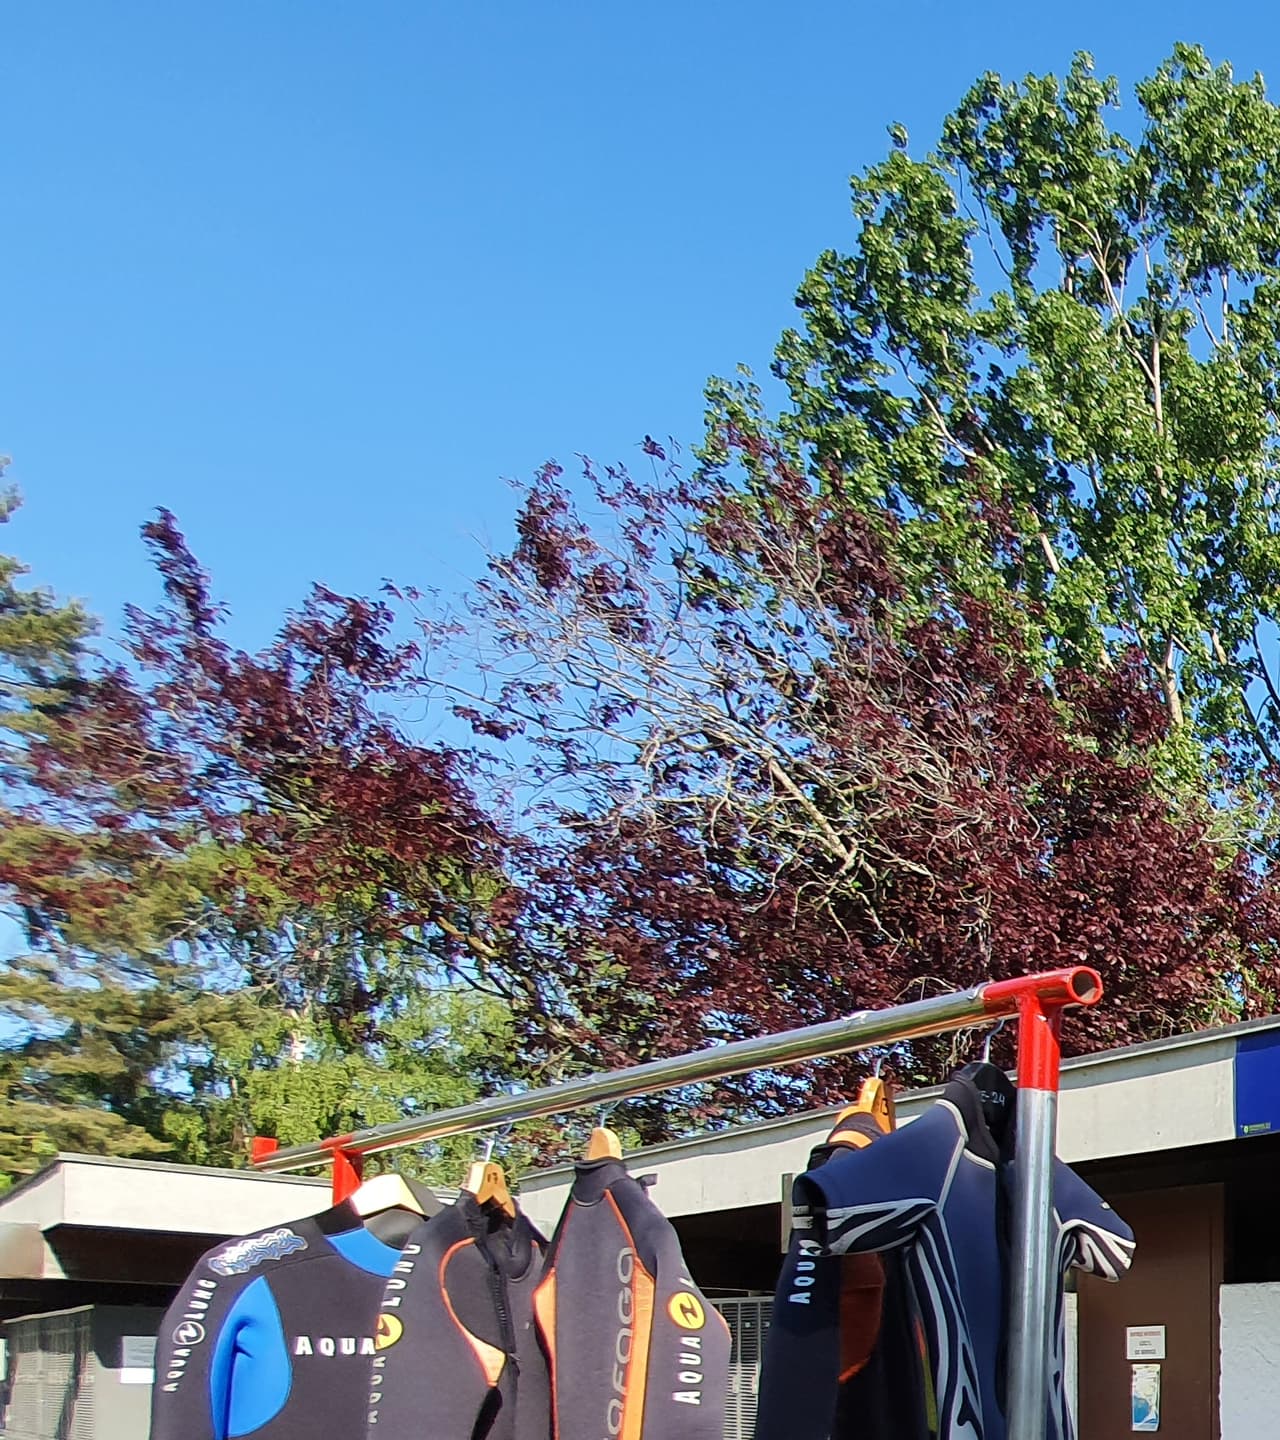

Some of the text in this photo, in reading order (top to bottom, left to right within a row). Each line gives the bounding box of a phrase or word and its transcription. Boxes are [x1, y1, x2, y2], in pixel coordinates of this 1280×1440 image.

[161, 1278, 217, 1392] AQUA LUNG
[294, 1335, 377, 1357] AQUA
[671, 1335, 704, 1405] AQUA
